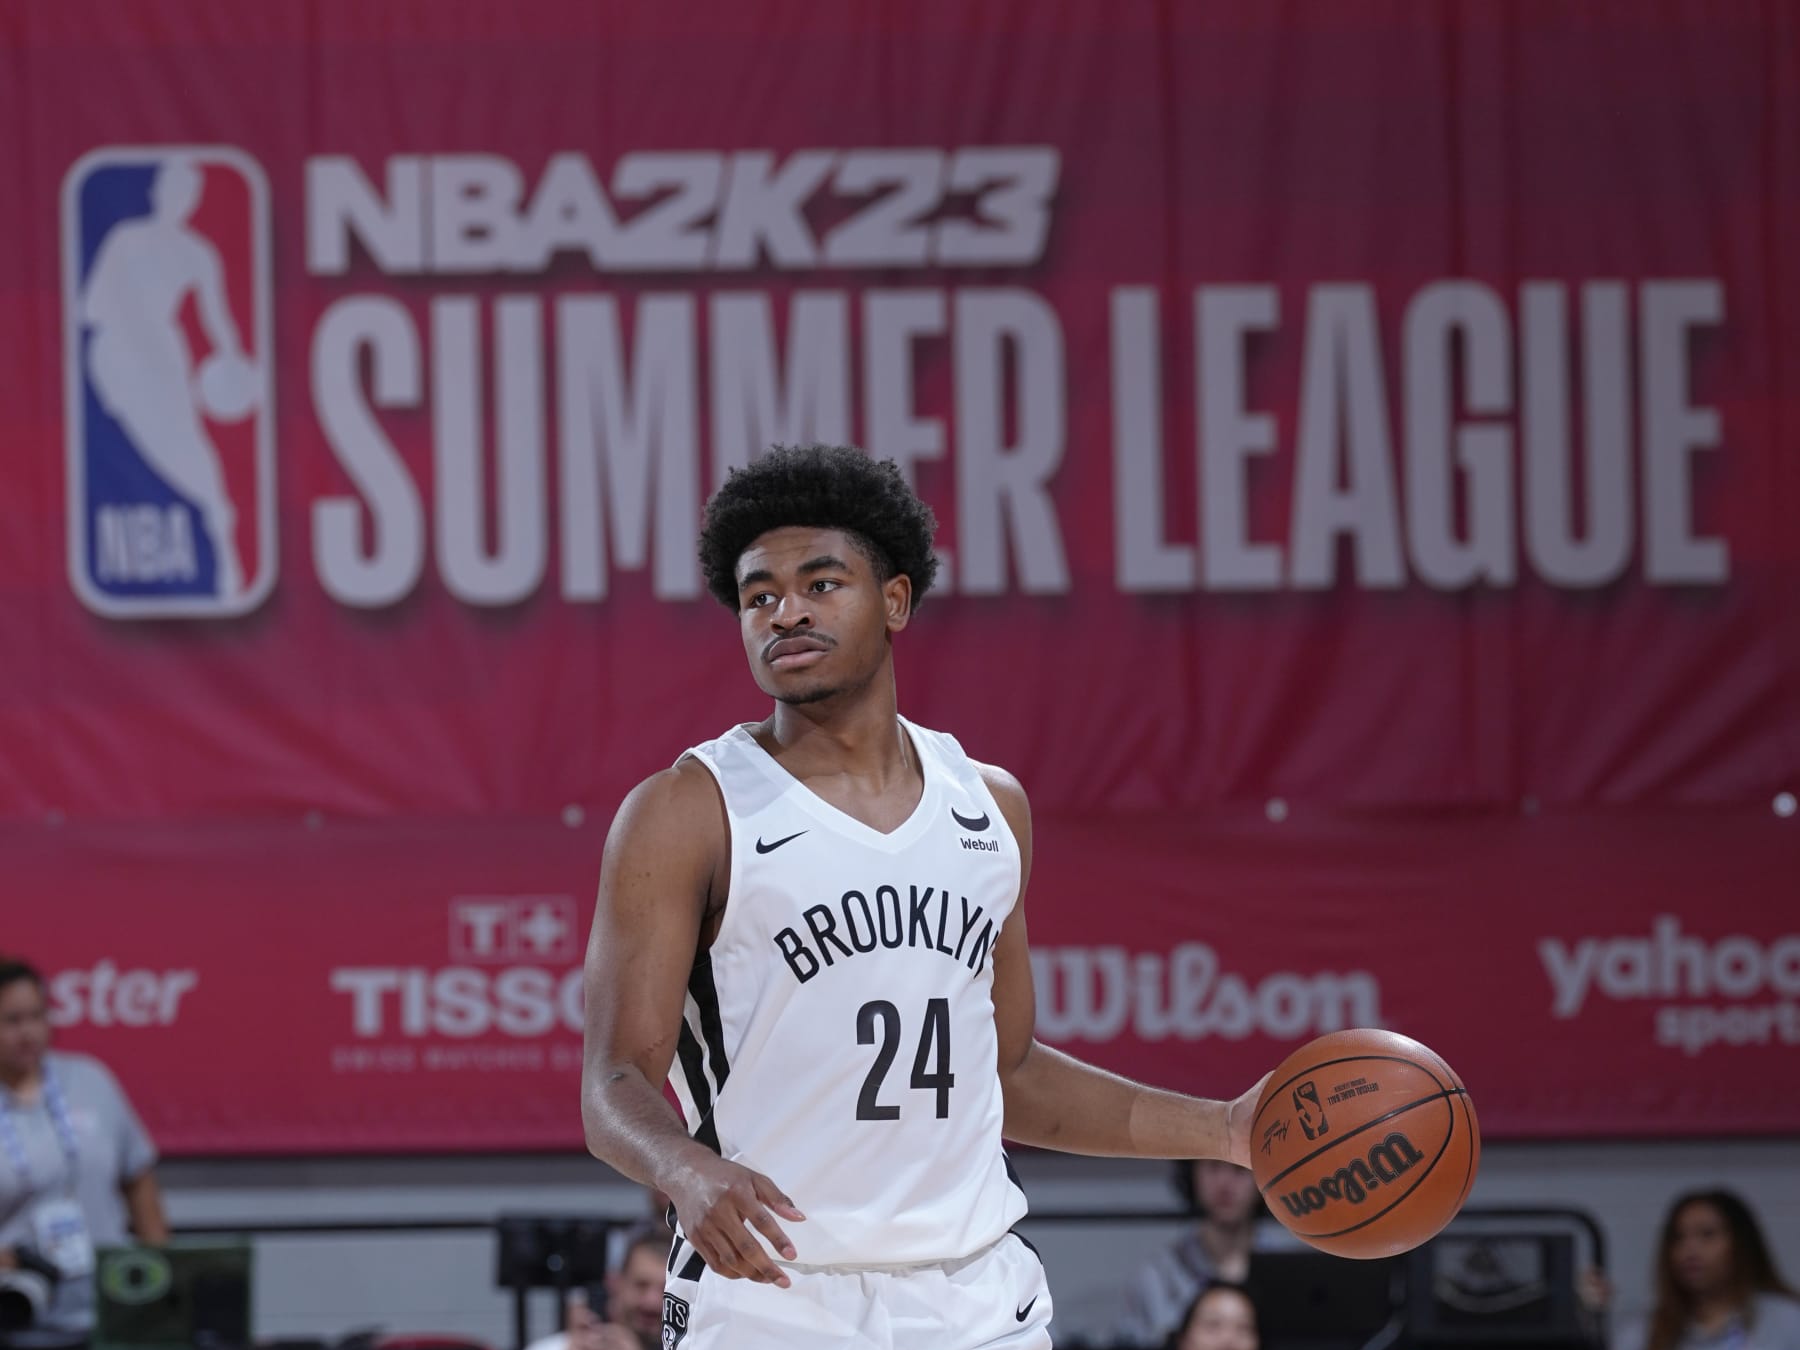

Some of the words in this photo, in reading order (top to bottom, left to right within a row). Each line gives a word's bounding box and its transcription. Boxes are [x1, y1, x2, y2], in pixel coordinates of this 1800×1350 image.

[310, 288, 1070, 606] SUMMER
[1110, 279, 1730, 592] LEAGUE
[97, 506, 196, 583] NBA
[960, 837, 999, 852] Webull
[774, 885, 999, 984] BROOKLYN
[1030, 942, 1382, 1041] Wilson
[856, 998, 955, 1121] 24
[1280, 1132, 1425, 1217] Wilson
